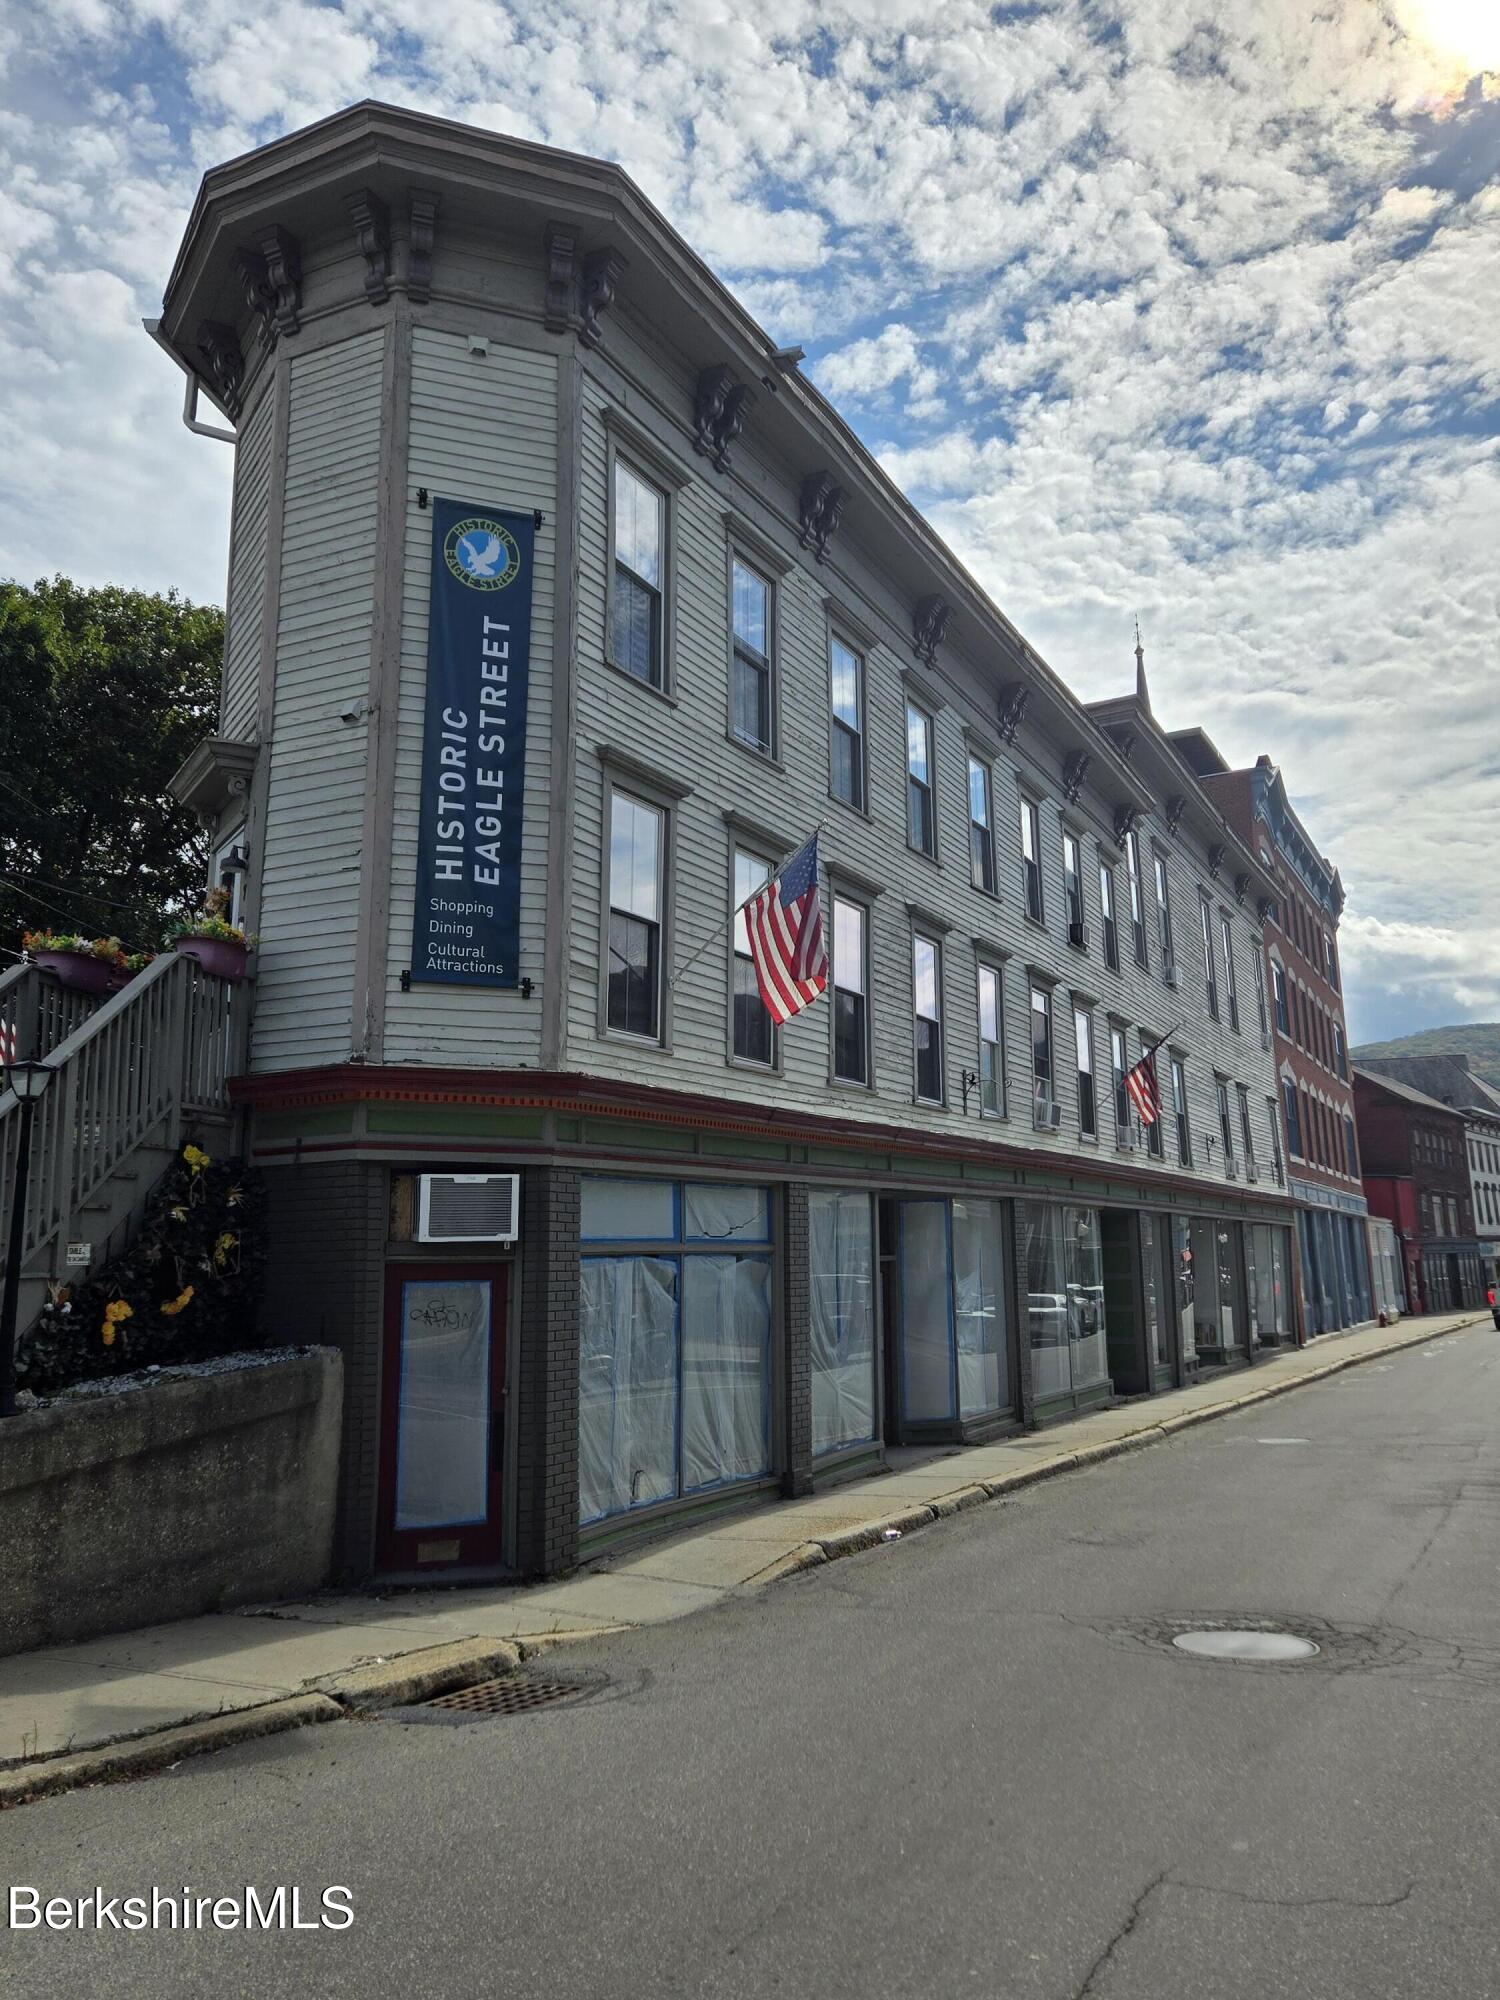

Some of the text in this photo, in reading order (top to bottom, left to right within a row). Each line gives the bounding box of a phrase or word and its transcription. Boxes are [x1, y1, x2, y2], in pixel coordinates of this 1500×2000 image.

[453, 519, 515, 546] HISTORIC
[444, 549, 475, 587] EAGLE
[474, 616, 511, 885] EAGLE STREET
[435, 707, 468, 880] HISTORIC
[430, 897, 494, 918] Shopping
[429, 919, 473, 938] Dining
[428, 942, 485, 958] Cultural
[426, 957, 504, 974] Attractions
